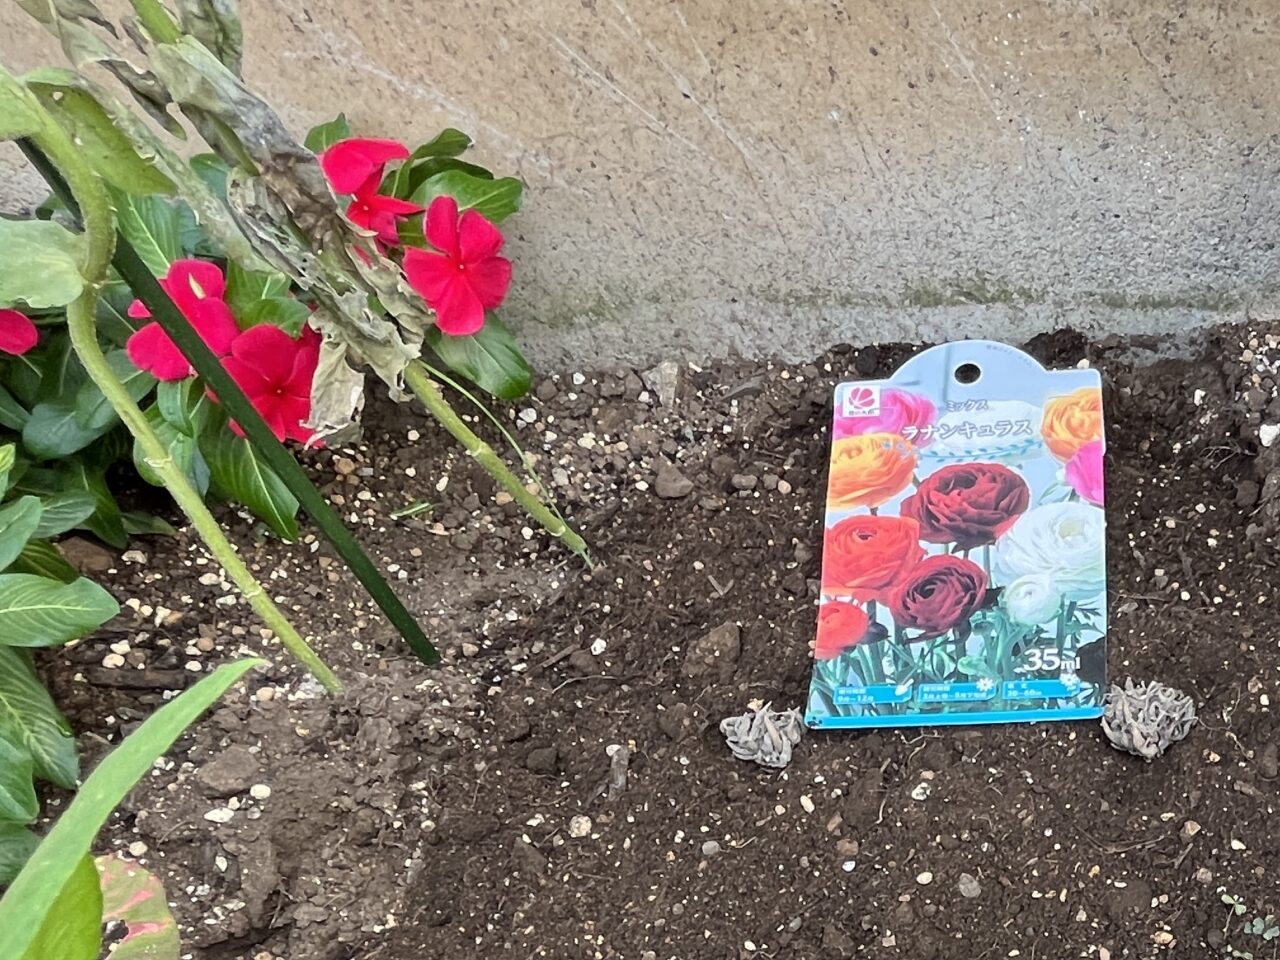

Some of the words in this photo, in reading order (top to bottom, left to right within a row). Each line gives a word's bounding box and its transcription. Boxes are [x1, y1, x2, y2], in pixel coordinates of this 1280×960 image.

[946, 400, 988, 412] ミックス
[902, 418, 1032, 442] ラナンキュラス
[1023, 648, 1081, 671] 35ml
